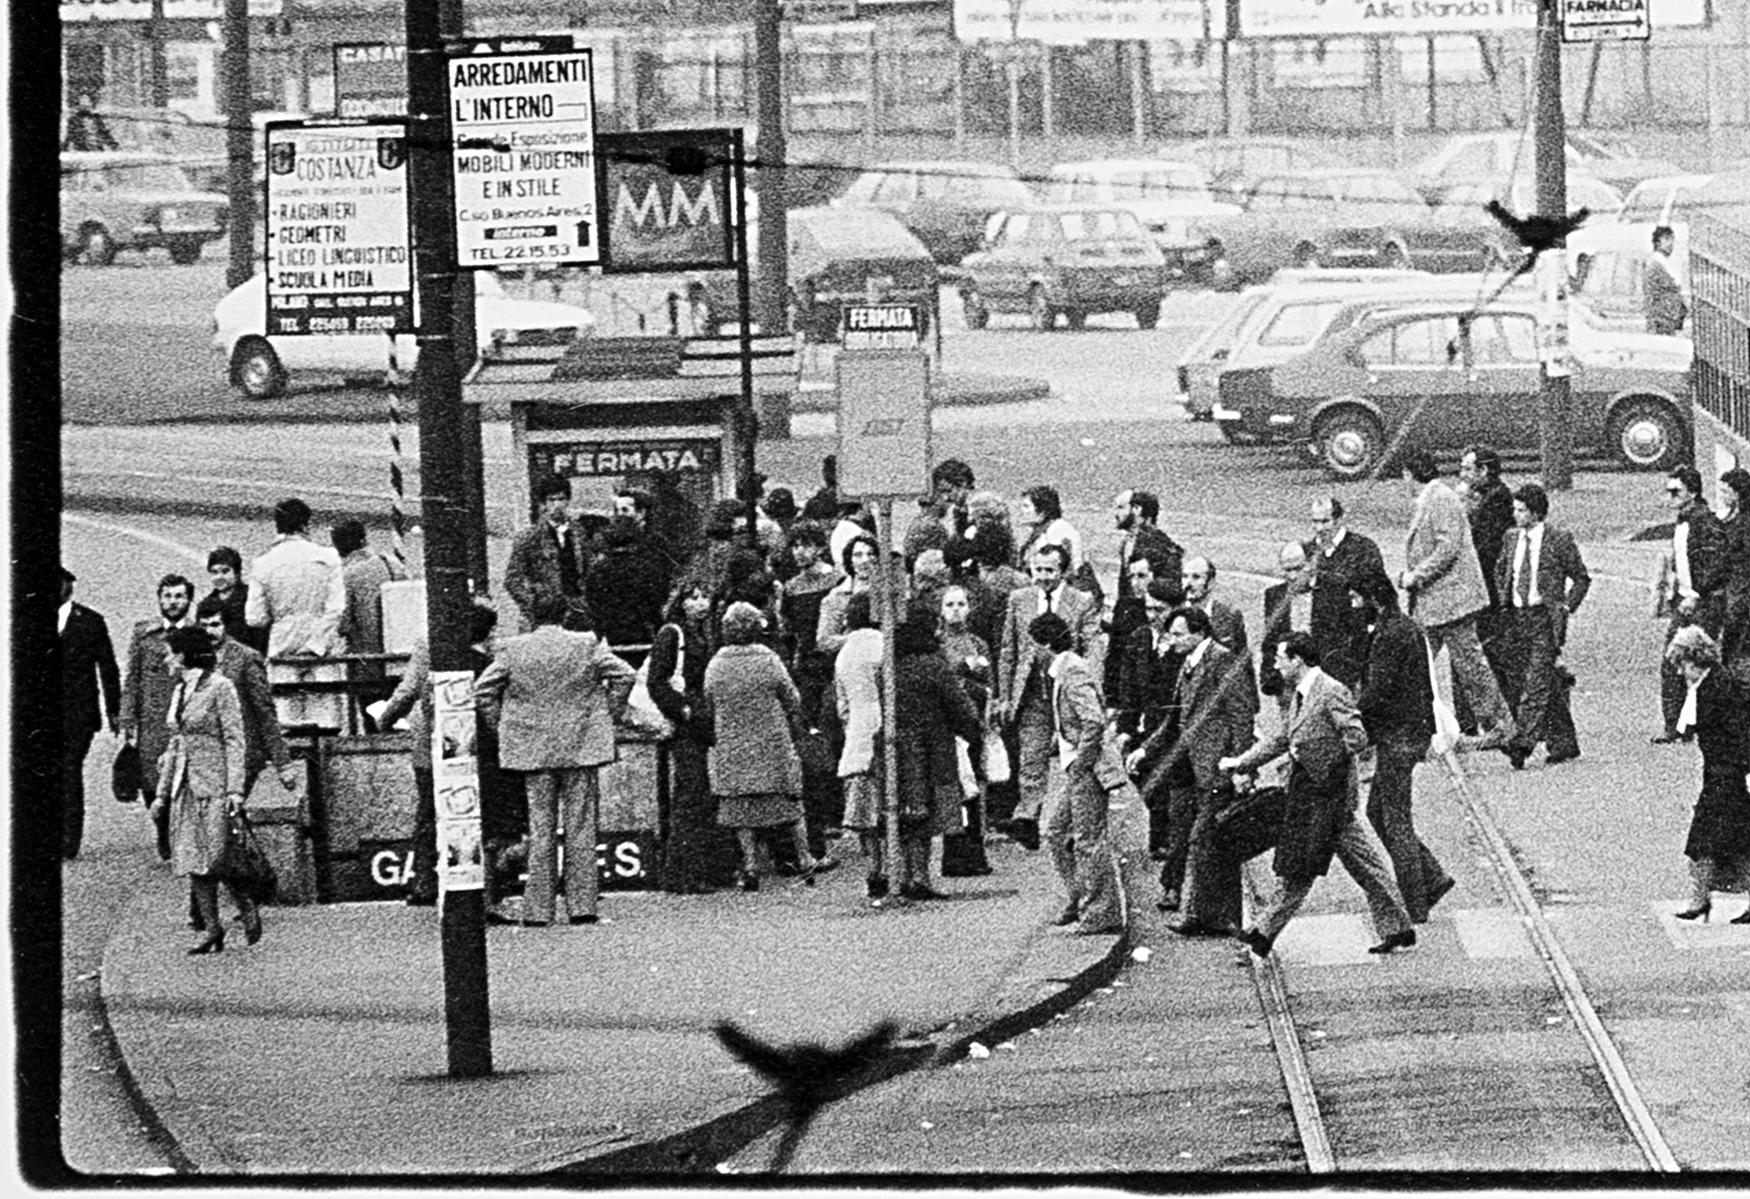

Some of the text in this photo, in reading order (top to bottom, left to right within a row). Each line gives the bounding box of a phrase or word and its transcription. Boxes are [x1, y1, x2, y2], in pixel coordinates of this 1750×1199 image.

[1411, 0, 1489, 19] Standa
[453, 58, 587, 88] ARREDAMENTI
[455, 93, 554, 122] L'INTERNO
[511, 130, 588, 148] Esposizione
[297, 155, 377, 181] COSTANZA
[457, 150, 590, 174] MOBILI MODERNI
[483, 177, 561, 199] E IN STILE
[279, 201, 357, 221] RAGIONIERI
[492, 207, 544, 221] Buenos
[613, 178, 721, 229] MM
[278, 225, 347, 245] GEOMETRI
[277, 245, 406, 267] LICEO LINGUISTICO
[277, 269, 375, 289] SCUOLA MEDIA
[848, 308, 914, 329] FERMATA
[552, 449, 701, 474] FERMATA
